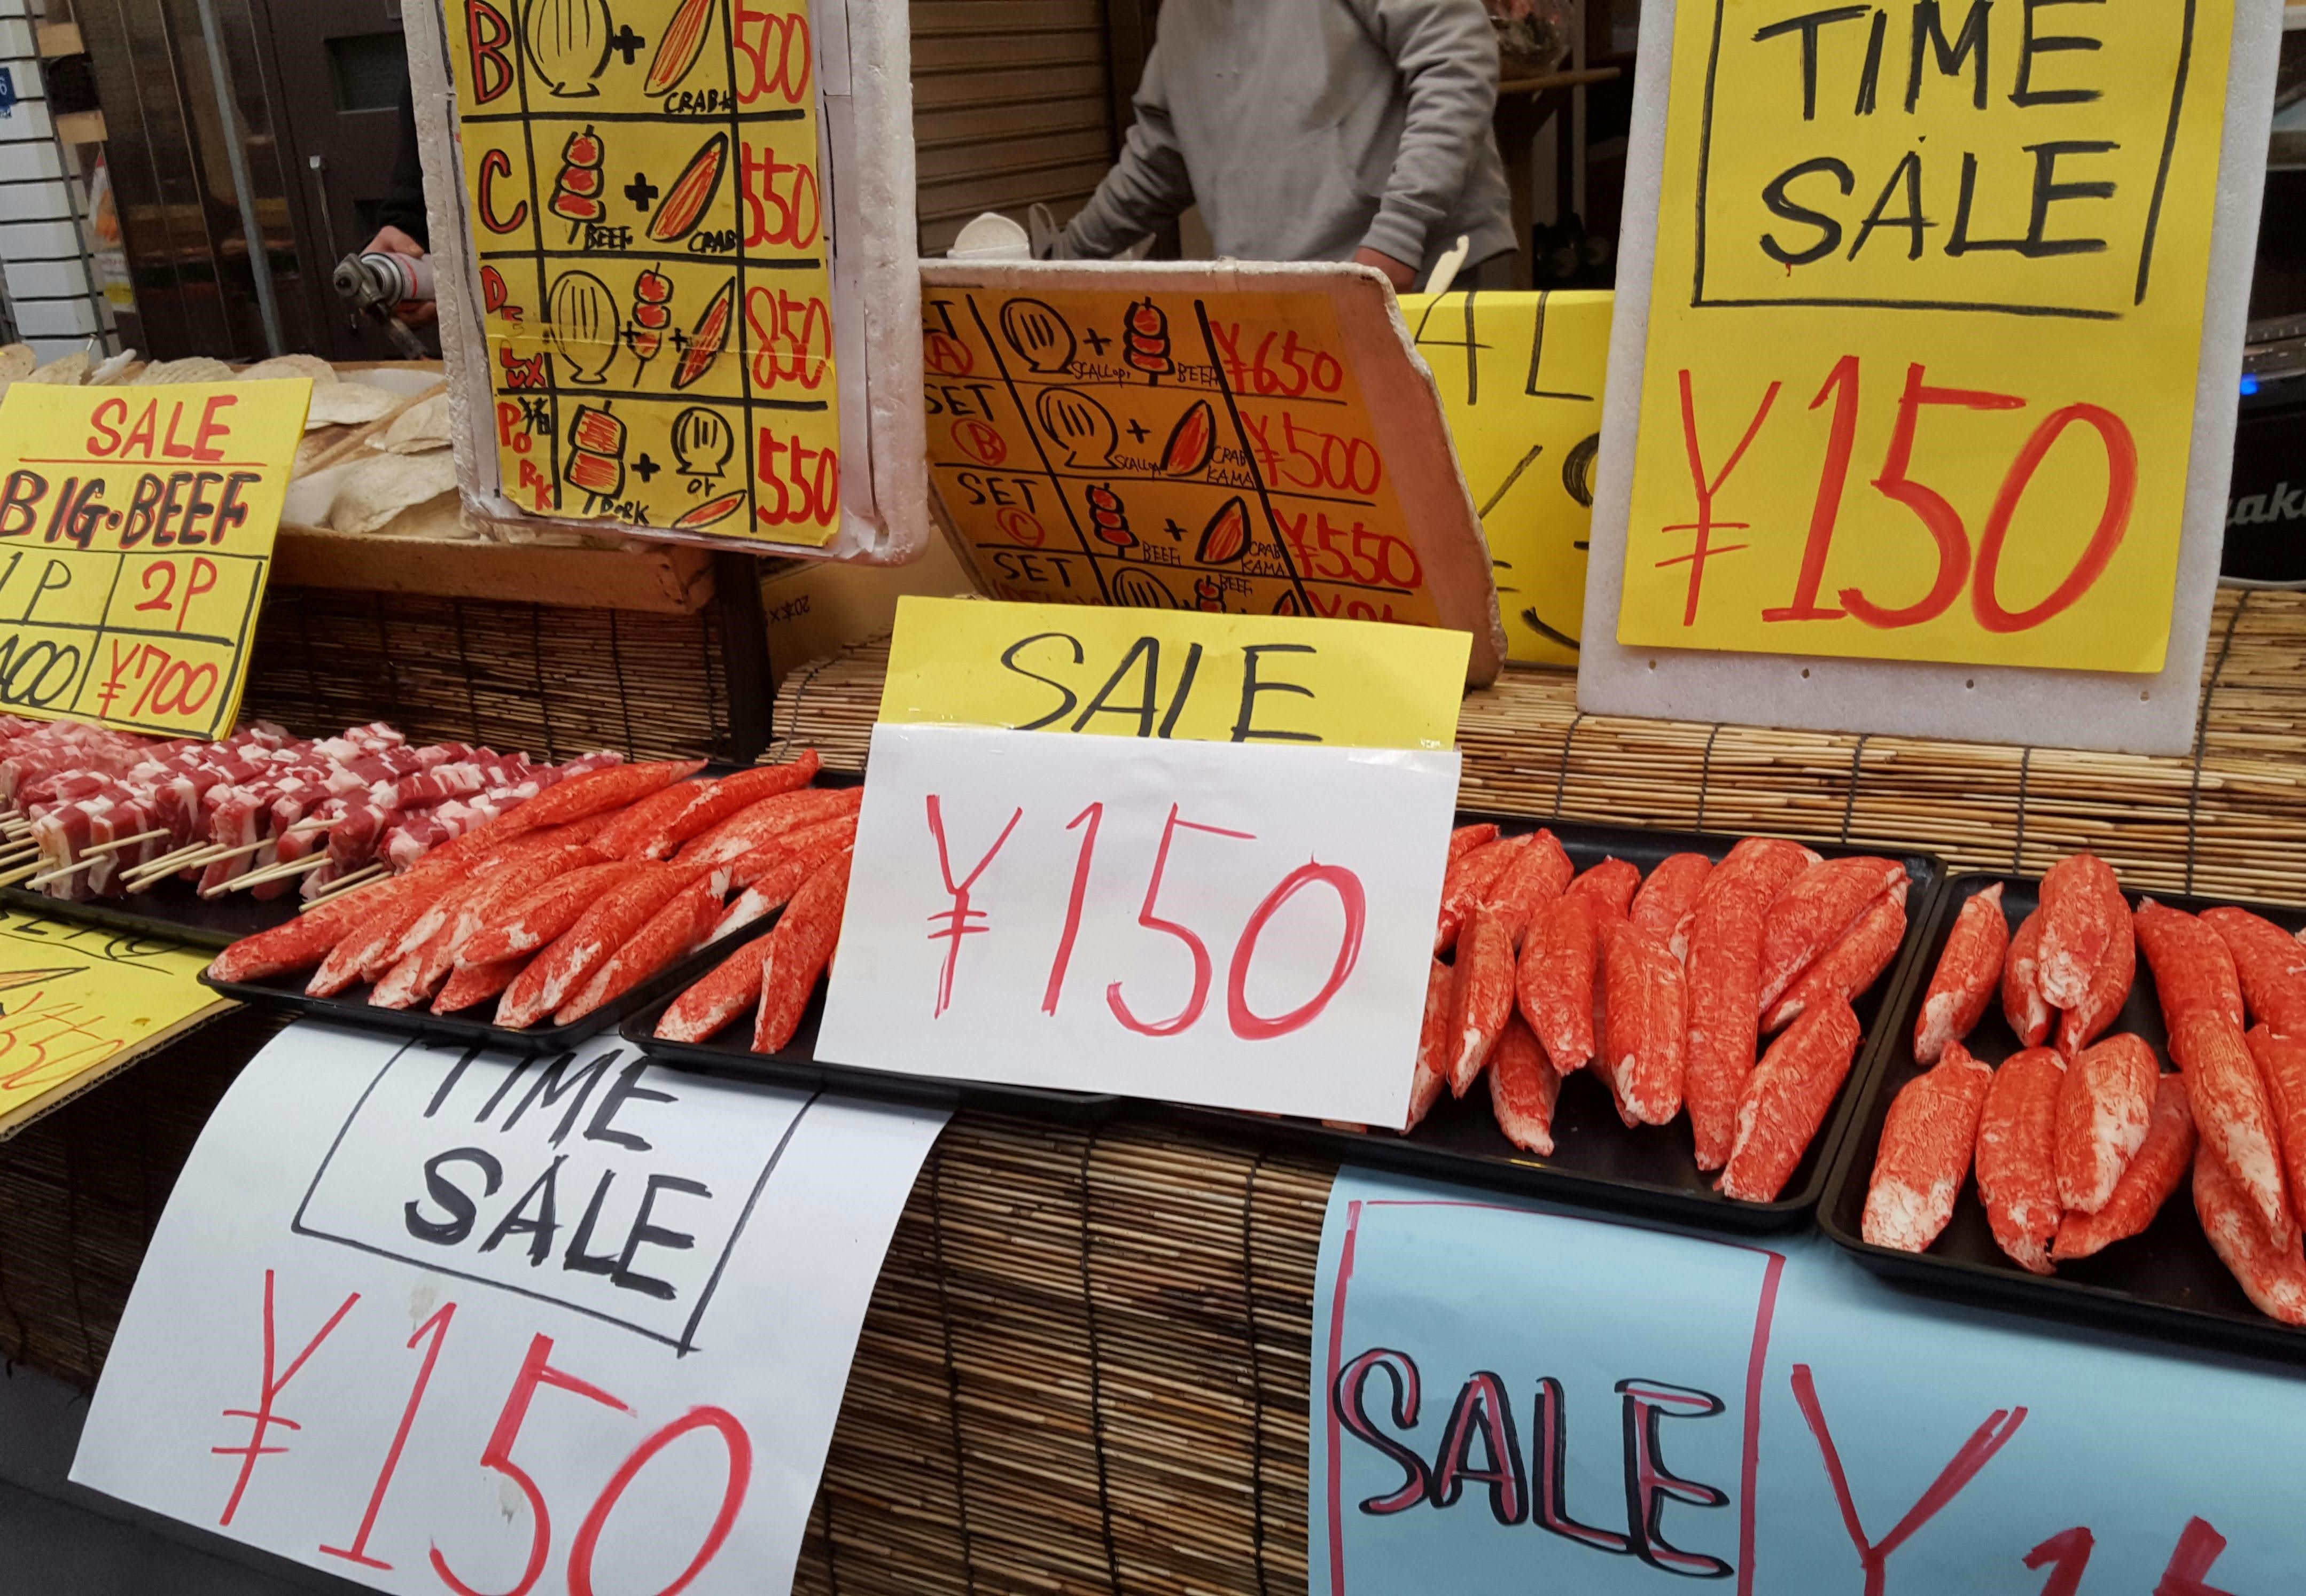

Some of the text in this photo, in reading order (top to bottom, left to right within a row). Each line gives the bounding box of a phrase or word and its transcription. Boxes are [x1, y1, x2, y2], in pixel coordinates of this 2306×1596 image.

[464, 0, 514, 106] B
[734, 0, 812, 105] 500
[1751, 0, 2106, 121] TIME
[478, 149, 527, 234] C
[742, 142, 821, 250] 550
[1759, 140, 2121, 265] SALE
[745, 286, 832, 389] 850
[1210, 320, 1343, 397] ¥650
[87, 394, 238, 461] SALE
[924, 383, 995, 423] SET
[1240, 410, 1382, 495] ¥500
[756, 427, 839, 527] 550
[957, 471, 1039, 514] SET
[1206, 465, 1256, 488] KAMA
[1655, 355, 2137, 634] ¥150
[134, 557, 217, 632] 2P
[993, 552, 1072, 588] SET
[1240, 556, 1285, 576] KAMA
[1272, 508, 1423, 588] ¥550
[97, 639, 218, 719] ¥700
[926, 795, 1366, 1040] ¥150
[424, 1039, 679, 1151] TIME
[404, 1146, 713, 1300] SALE
[211, 1268, 753, 1596] ¥150
[1336, 1348, 1735, 1579] SALE
